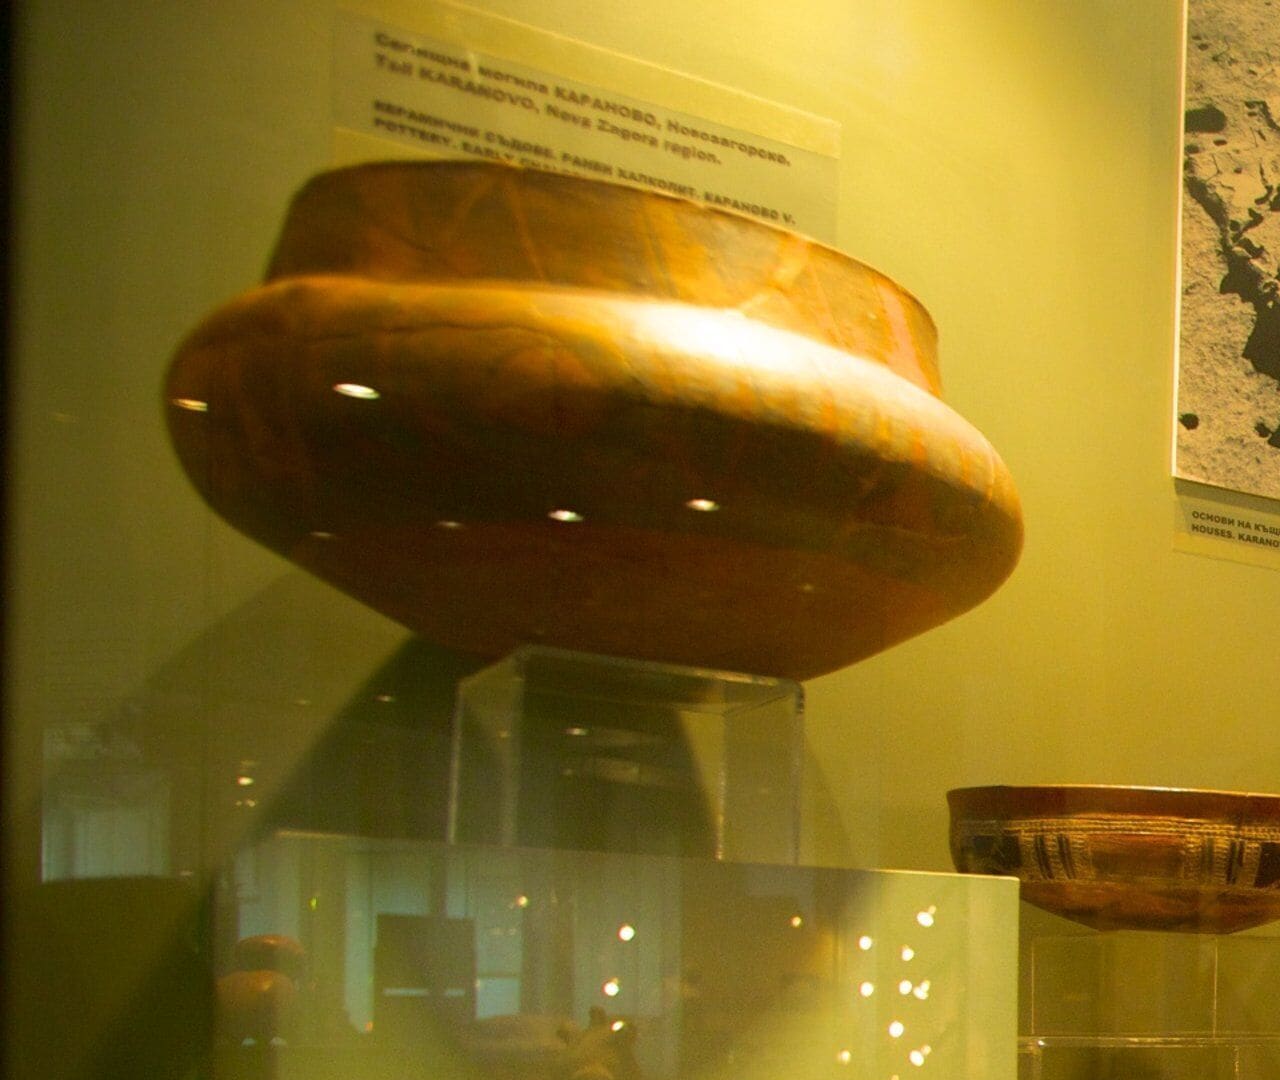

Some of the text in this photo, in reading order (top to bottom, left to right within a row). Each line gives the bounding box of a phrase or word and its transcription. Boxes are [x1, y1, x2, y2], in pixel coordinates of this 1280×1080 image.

[419, 68, 540, 113] KARANOVO,
[597, 118, 659, 147] Zagora
[555, 86, 661, 129] КАРАНОВО,
[1191, 524, 1235, 539] HOUSES.
[1192, 511, 1235, 526] ОСНОВИ
[1237, 520, 1252, 530] НА
